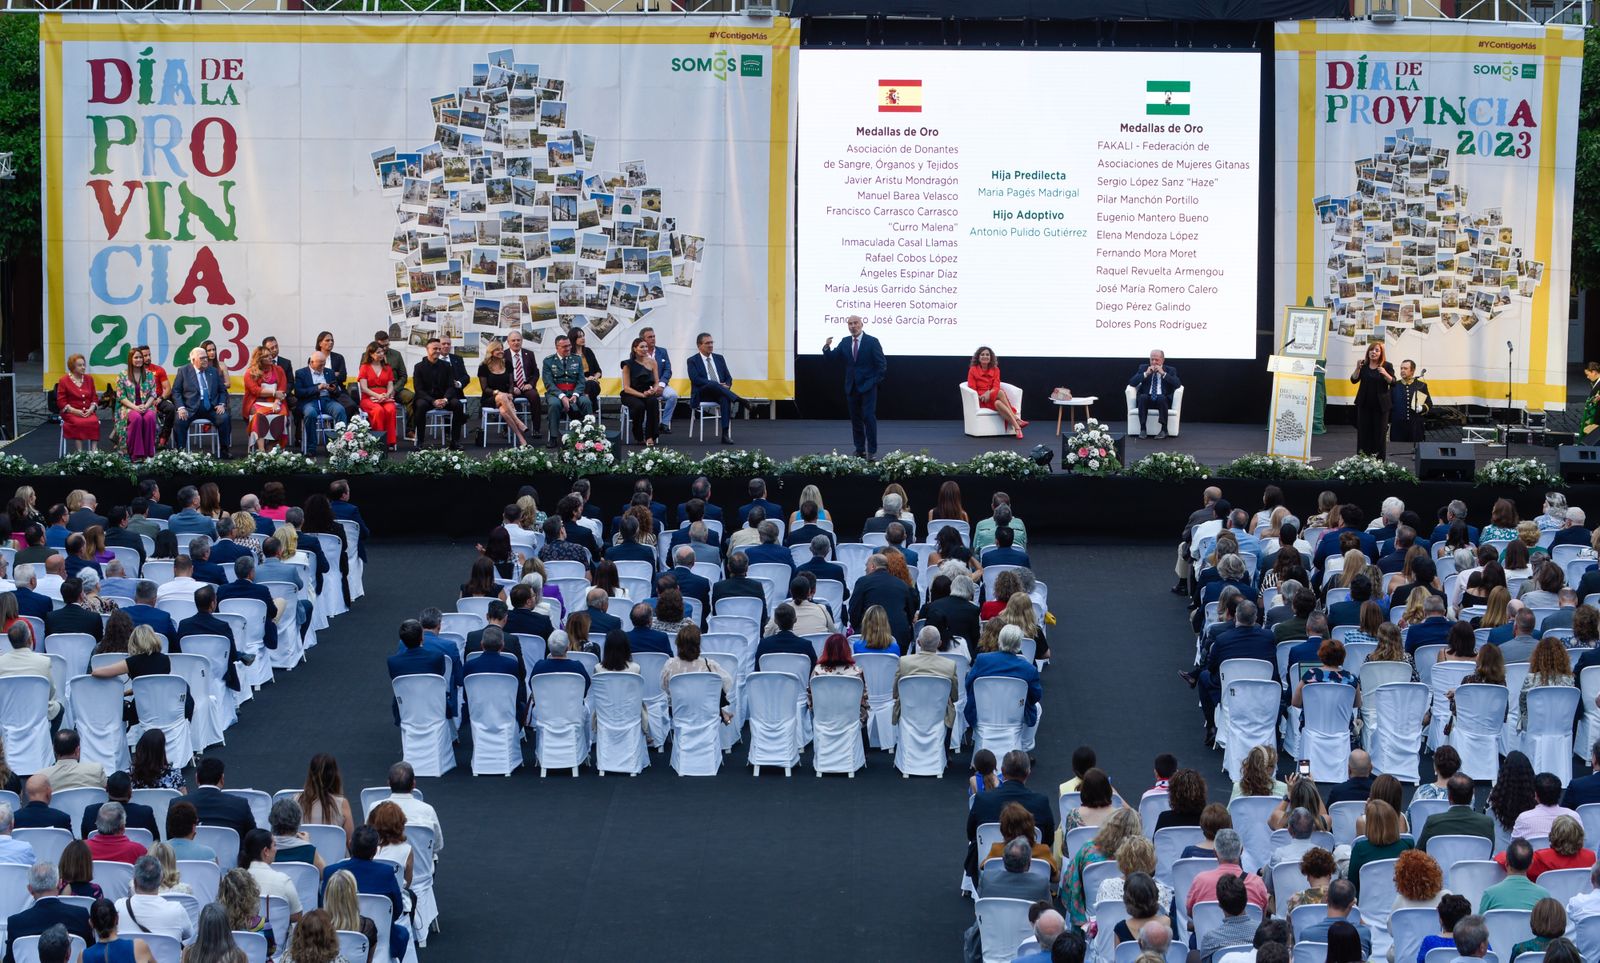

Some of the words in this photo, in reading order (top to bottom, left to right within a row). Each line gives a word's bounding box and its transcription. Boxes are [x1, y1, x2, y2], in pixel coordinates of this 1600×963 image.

[709, 31, 768, 41] #YContigoMás
[1478, 40, 1537, 50] #YContigoMás
[671, 57, 737, 73] SOMOS
[86, 46, 197, 106] DÍA
[200, 58, 244, 81] DE
[1325, 54, 1392, 91] DÍA
[1395, 61, 1423, 76] DE
[1395, 77, 1421, 91] LA
[200, 83, 241, 106] LA
[1325, 94, 1538, 128] PROVINCIA
[856, 126, 901, 137] Medallas
[903, 126, 917, 137] de
[919, 126, 939, 137] Oro
[1120, 122, 1165, 133] Medallas
[1167, 123, 1181, 134] de
[1183, 123, 1204, 134] Oro
[86, 113, 239, 178] PRO
[846, 144, 898, 154] Asociación
[899, 144, 912, 154] de
[914, 144, 959, 154] Donantes
[1097, 140, 1133, 151] FAKALI
[1142, 141, 1195, 152] Federación
[1197, 141, 1210, 152] de
[1455, 130, 1532, 159] 2023
[823, 159, 836, 169] de
[838, 159, 873, 171] Sangre,
[875, 158, 916, 171] Órganos
[917, 162, 924, 172] y
[926, 159, 959, 172] Tejidos
[1097, 159, 1159, 169] Asociaciones
[1161, 159, 1174, 169] de
[1176, 159, 1212, 171] Mujeres
[1214, 159, 1250, 170] Gitanas
[844, 175, 873, 185] Javier
[875, 175, 903, 185] Aristu
[905, 175, 959, 187] Mondragón
[991, 169, 1011, 182] Hija
[1014, 170, 1067, 181] Predilecta
[1097, 176, 1128, 188] Sergio
[1130, 177, 1159, 188] López
[1161, 177, 1184, 187] Sanz
[857, 191, 891, 201] Manuel
[893, 190, 920, 201] Barea
[922, 191, 959, 201] Velasco
[1006, 187, 1036, 199] Pagés
[1038, 187, 1080, 200] Madrigal
[1097, 194, 1117, 204] Pilar
[1120, 194, 1163, 205] Manchón
[1165, 194, 1200, 205] Portillo
[86, 179, 239, 242] VIN
[826, 205, 871, 216] Francisco
[873, 206, 915, 216] Carrasco
[916, 206, 959, 217] Carrasco
[993, 209, 1014, 222] Hijo
[1016, 209, 1065, 222] Adoptivo
[1096, 212, 1136, 224] Eugenio
[1137, 212, 1176, 223] Mantero
[1178, 212, 1209, 223] Bueno
[969, 226, 1008, 237] Antonio
[1010, 227, 1041, 237] Pulido
[1043, 227, 1088, 238] Gutiérrez
[1096, 229, 1123, 240] Elena
[1125, 230, 1168, 240] Mendoza
[1170, 231, 1199, 242] López
[842, 237, 896, 247] Inmaculada
[897, 237, 923, 248] Casal
[925, 237, 959, 248] Llamas
[865, 252, 894, 263] Rafael
[896, 252, 927, 263] Cobos
[929, 253, 958, 265] López
[1096, 247, 1141, 258] Fernando
[1144, 248, 1167, 258] Mora
[1170, 248, 1197, 258] Moret
[89, 244, 236, 305] CIA
[860, 266, 898, 279] Ángeles
[900, 268, 935, 280] Espinar
[1096, 265, 1129, 277] Raquel
[1131, 266, 1172, 276] Revuelta
[1174, 266, 1224, 278] Armengou
[852, 283, 879, 294] Jesús
[880, 283, 917, 294] Garrido
[918, 284, 958, 294] Sánchez
[1096, 283, 1118, 294] José
[1148, 283, 1186, 294] Romero
[1187, 284, 1218, 294] Calero
[836, 299, 871, 309] Cristina
[874, 299, 907, 309] Heeren
[909, 299, 958, 310] Sotomaior
[1096, 301, 1124, 313] Diego
[1126, 301, 1152, 312] Pérez
[1154, 301, 1191, 312] Galindo
[824, 314, 869, 325] Franco
[871, 315, 893, 325] José
[928, 315, 958, 325] Porras
[1096, 318, 1132, 329] Dolores
[1134, 319, 1157, 329] Pons
[89, 312, 250, 371] 2023
